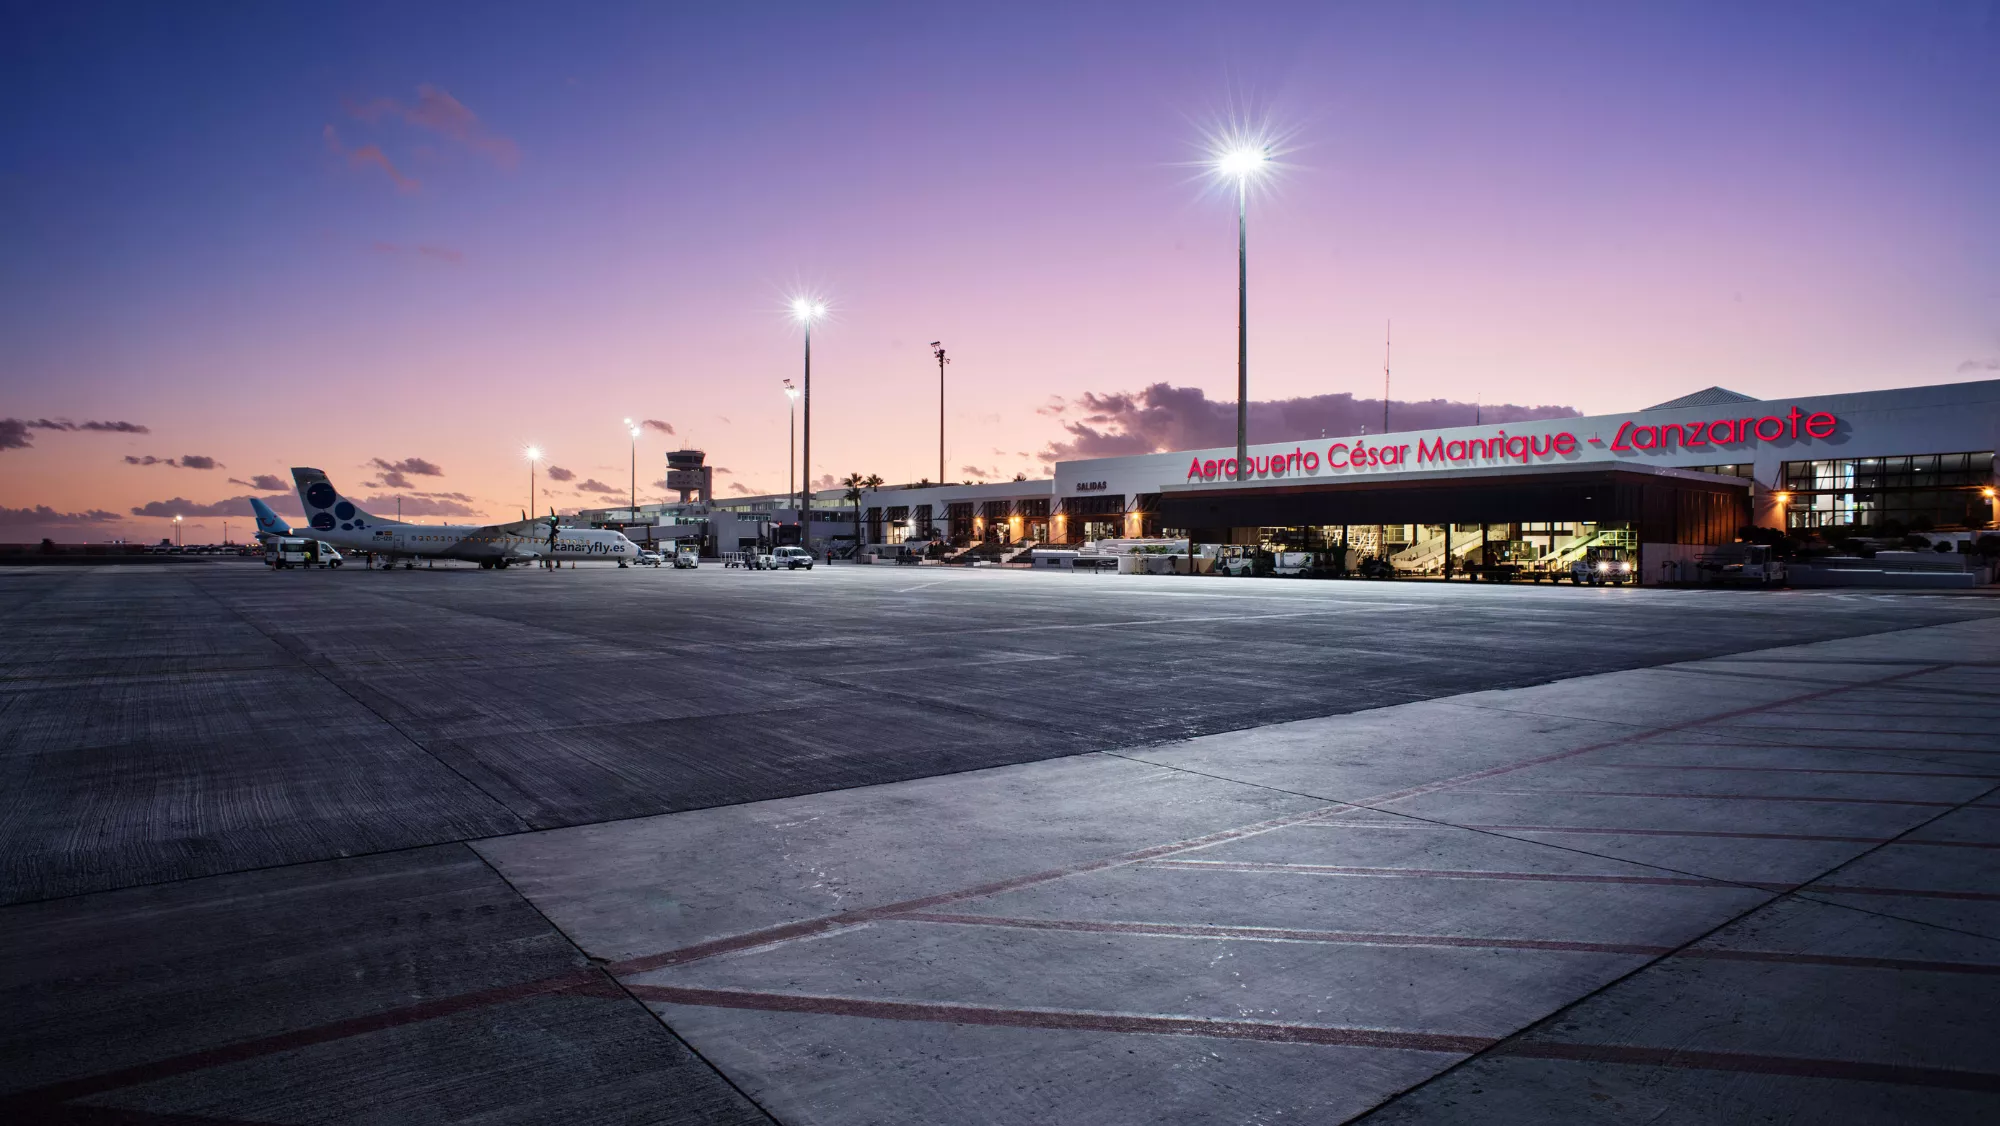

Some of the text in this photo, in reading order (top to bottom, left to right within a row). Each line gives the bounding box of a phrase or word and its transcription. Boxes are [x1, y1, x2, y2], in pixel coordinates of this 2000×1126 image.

[1327, 439, 1409, 469] César
[1417, 430, 1576, 464] Manrique
[1610, 405, 1836, 451] Lanzarote
[1076, 481, 1107, 491] SALIDAS
[554, 541, 625, 554] canaryfly.es
